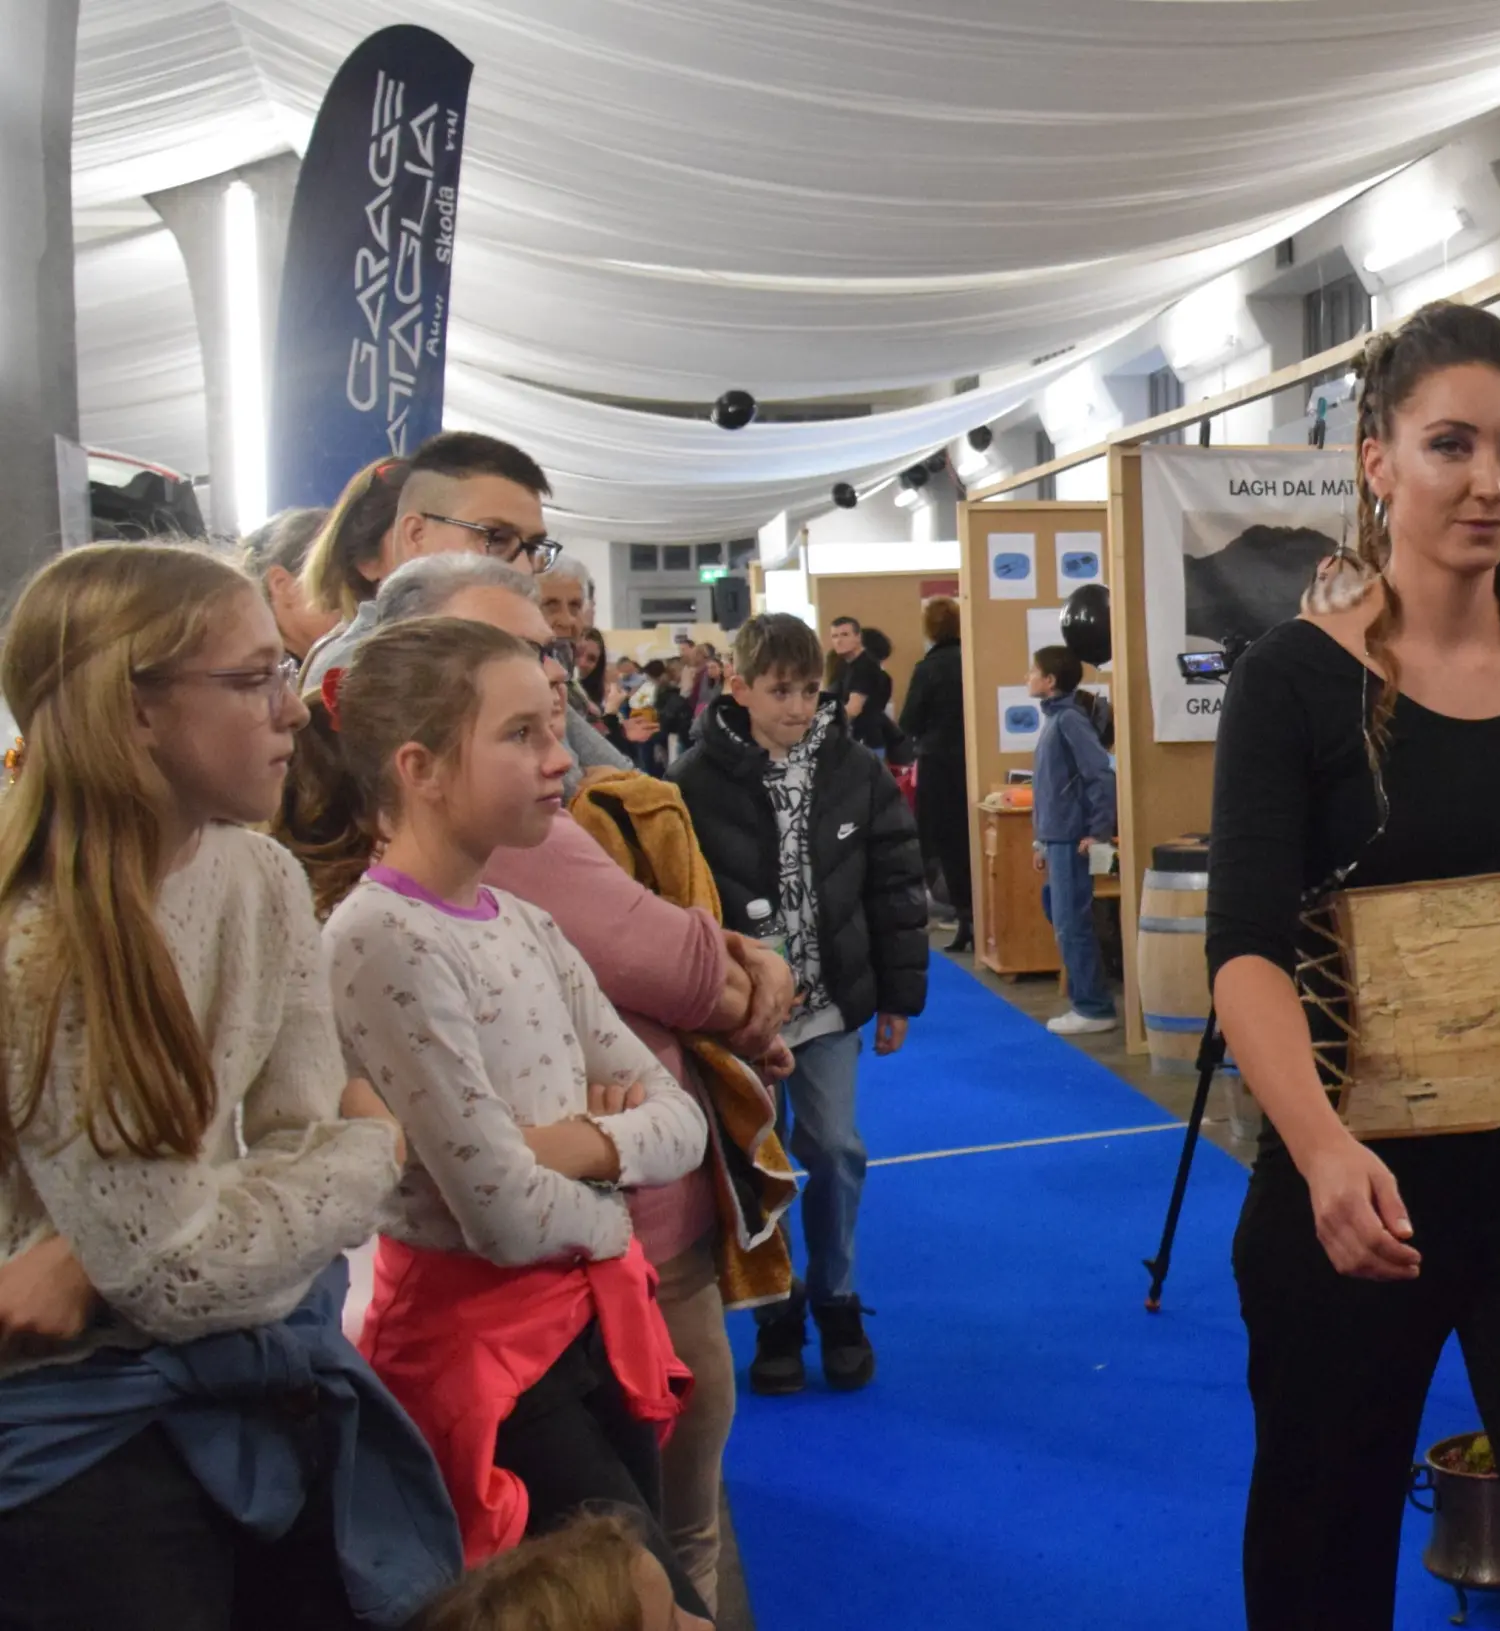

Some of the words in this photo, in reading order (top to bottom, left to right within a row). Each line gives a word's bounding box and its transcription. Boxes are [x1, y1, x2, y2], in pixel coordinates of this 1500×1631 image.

[346, 70, 405, 413] GARAGE
[434, 186, 455, 264] Skoda
[1229, 480, 1277, 496] LAGH
[1283, 480, 1316, 496] DAL
